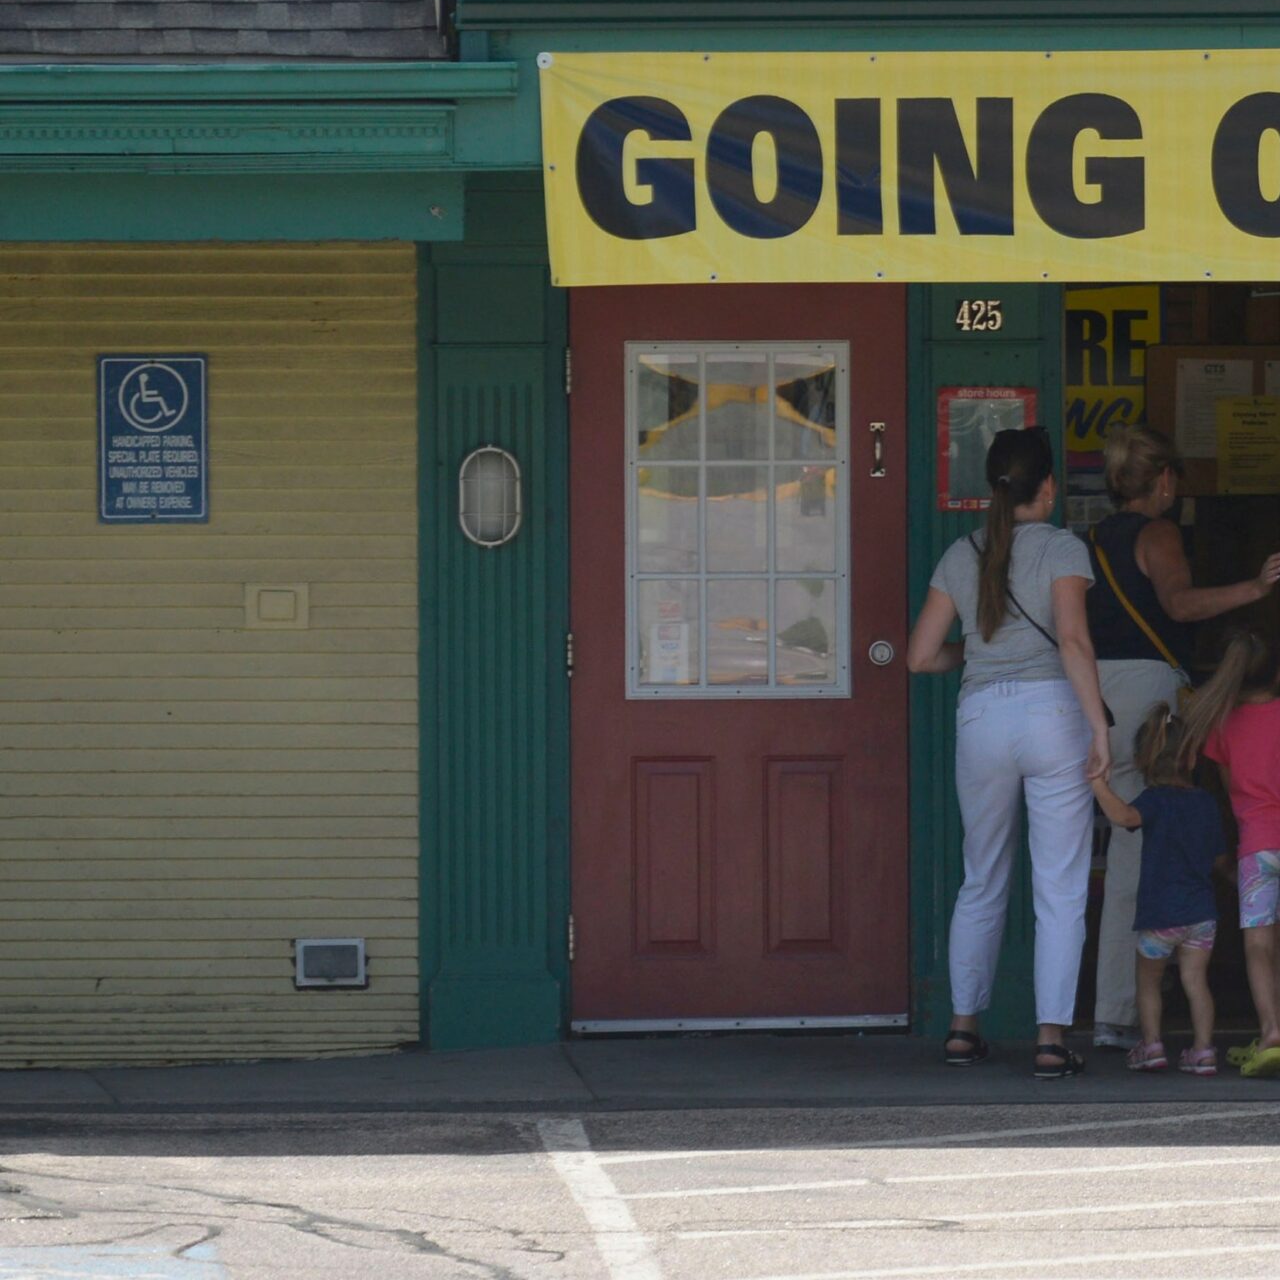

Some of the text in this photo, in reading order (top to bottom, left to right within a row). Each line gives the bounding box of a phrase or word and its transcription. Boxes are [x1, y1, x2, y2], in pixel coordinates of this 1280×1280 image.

[575, 92, 1146, 240] GOING
[955, 299, 1003, 331] 425
[957, 388, 1017, 398] store hours
[112, 435, 161, 448] HANDICAPPED
[108, 450, 138, 463] SPECIAL
[138, 450, 161, 463] PLATE
[109, 466, 199, 478] UNAUTHORIZED VEHICLES
[139, 481, 150, 493] BE
[150, 481, 185, 493] REMOVED
[115, 496, 125, 508] AT
